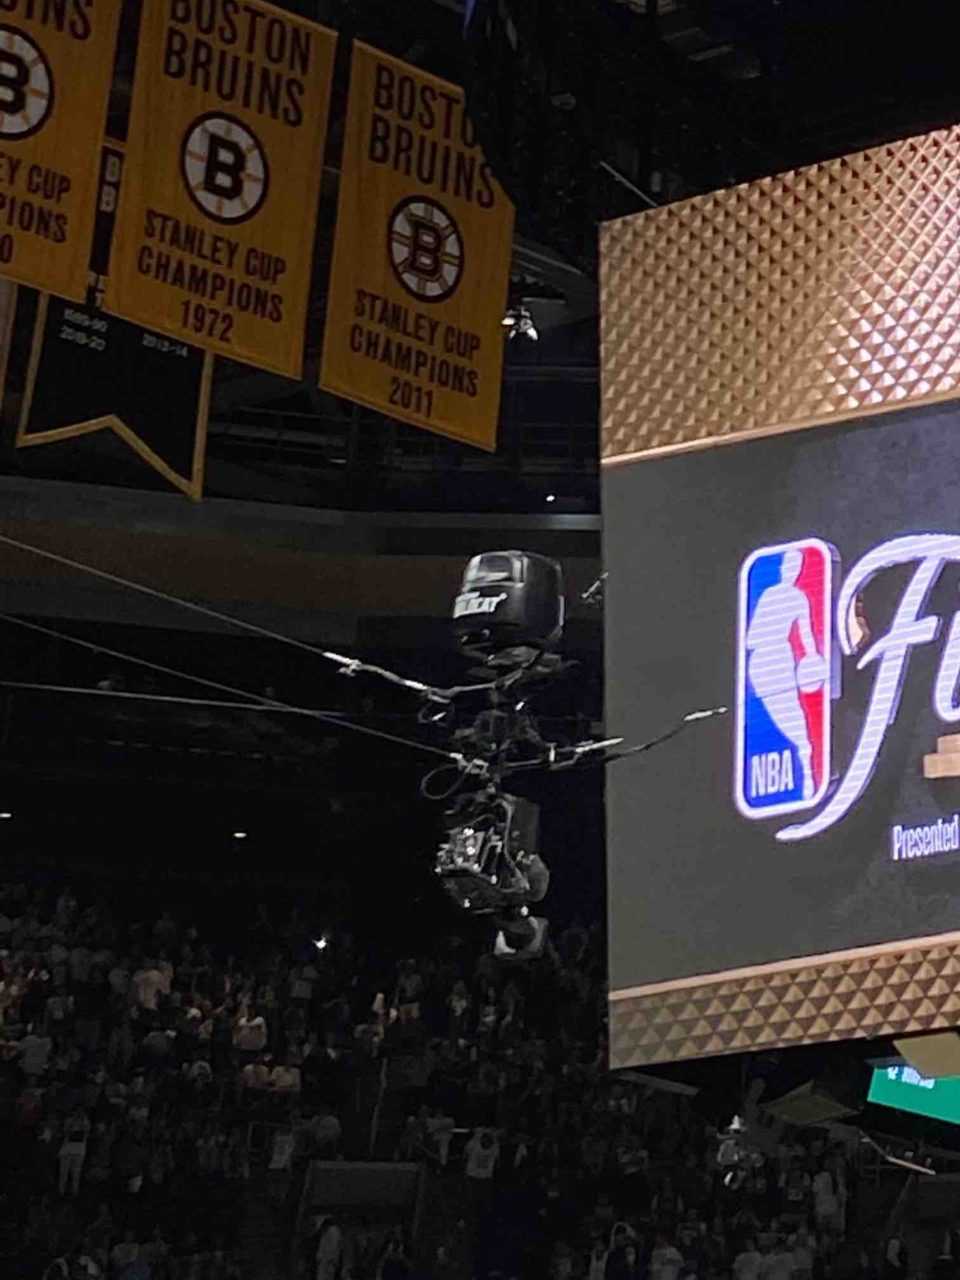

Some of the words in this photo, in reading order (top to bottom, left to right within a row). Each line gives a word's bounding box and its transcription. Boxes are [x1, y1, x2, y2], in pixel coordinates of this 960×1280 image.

[164, 26, 305, 127] BRUINS
[27, 164, 72, 204] CUP
[203, 132, 246, 200] B
[368, 113, 495, 209] BRUINS
[145, 209, 240, 270] STANLEY
[245, 246, 287, 286] CUP
[408, 221, 444, 277] B
[137, 245, 283, 323] CHAMPIONS
[181, 299, 234, 343] 1972
[354, 288, 440, 347] STANLEY
[444, 325, 481, 361] CUP
[350, 323, 479, 398] CHAMPIONS
[388, 375, 435, 419] 2011
[751, 754, 794, 797] NBA
[892, 817, 957, 860] Presented
